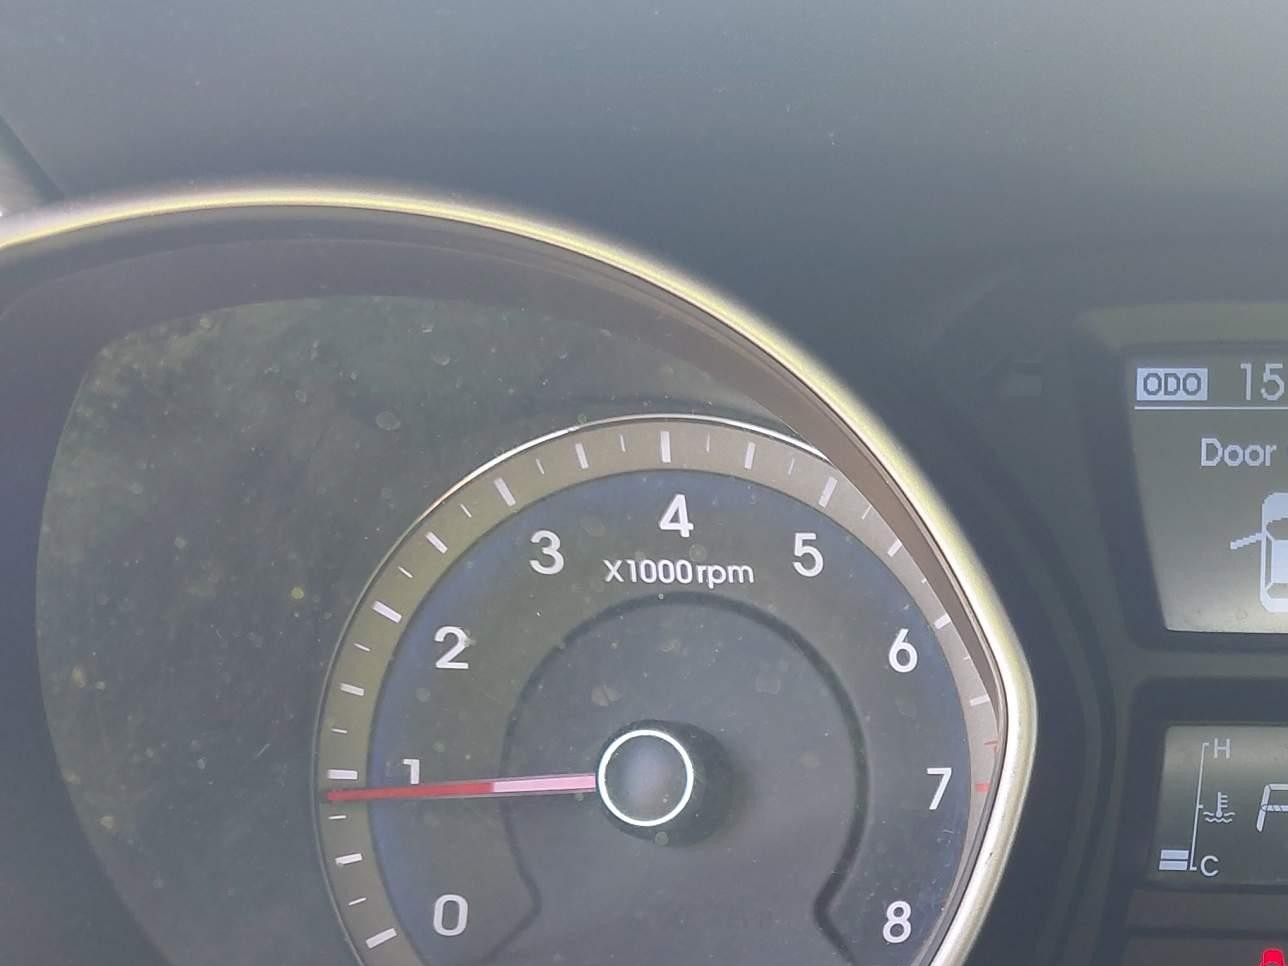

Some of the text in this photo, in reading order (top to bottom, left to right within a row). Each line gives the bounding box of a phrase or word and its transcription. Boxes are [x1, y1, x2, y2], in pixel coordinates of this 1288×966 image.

[1142, 372, 1202, 396] ODO
[1200, 437, 1277, 467] Door
[658, 494, 693, 538] 4
[529, 530, 564, 575] 3
[604, 558, 755, 588] X1000 rpm
[793, 532, 824, 577] 5
[434, 626, 470, 670] 2
[888, 628, 919, 674] 6
[1213, 738, 1232, 759] H
[926, 768, 952, 810] 7
[1200, 855, 1219, 877] C
[433, 894, 468, 936] 0
[883, 900, 912, 944] 8
